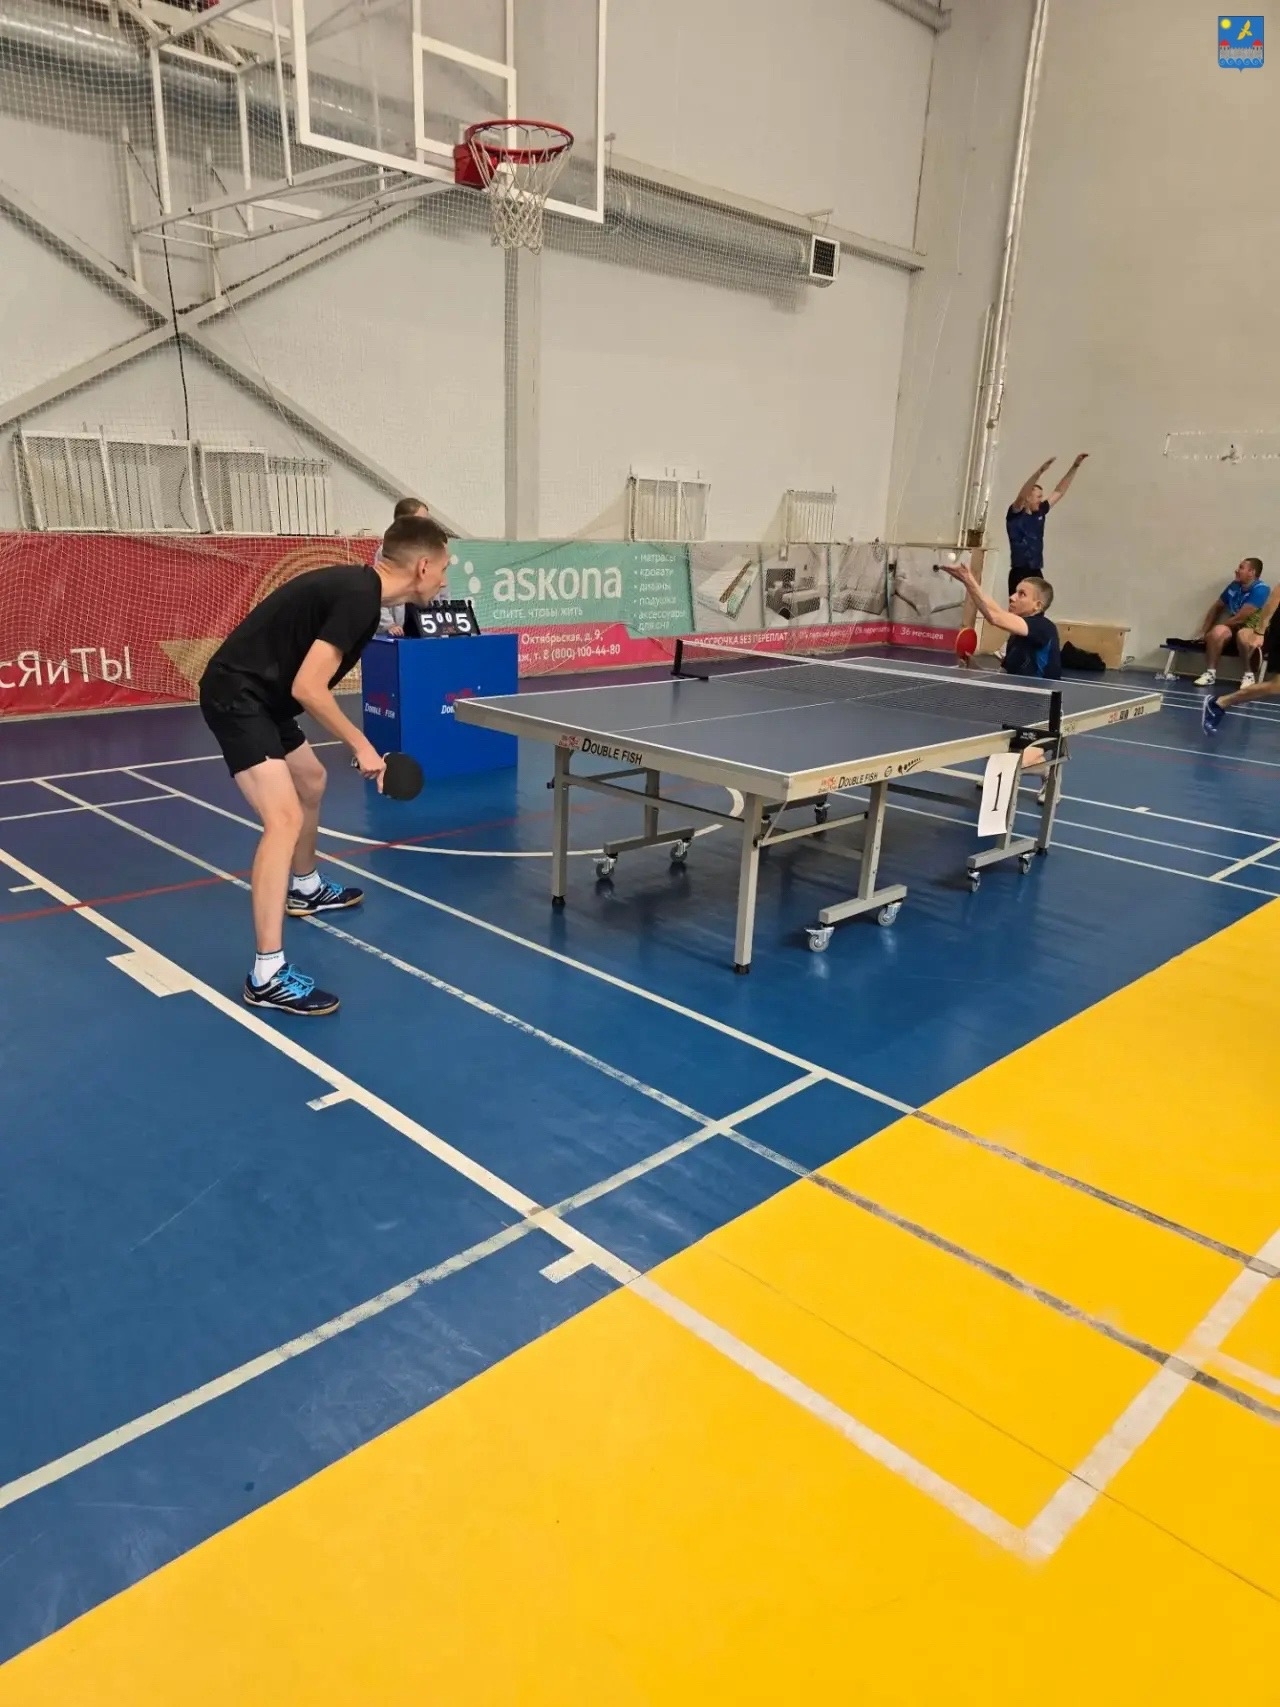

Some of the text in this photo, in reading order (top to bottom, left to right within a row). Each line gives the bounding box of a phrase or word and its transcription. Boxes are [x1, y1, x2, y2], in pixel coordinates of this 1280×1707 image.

[493, 566, 623, 602] askona
[900, 627, 911, 636] 36
[577, 644, 621, 657] 100-44-80
[621, 750, 643, 765] FISH
[993, 771, 1003, 812] 1
